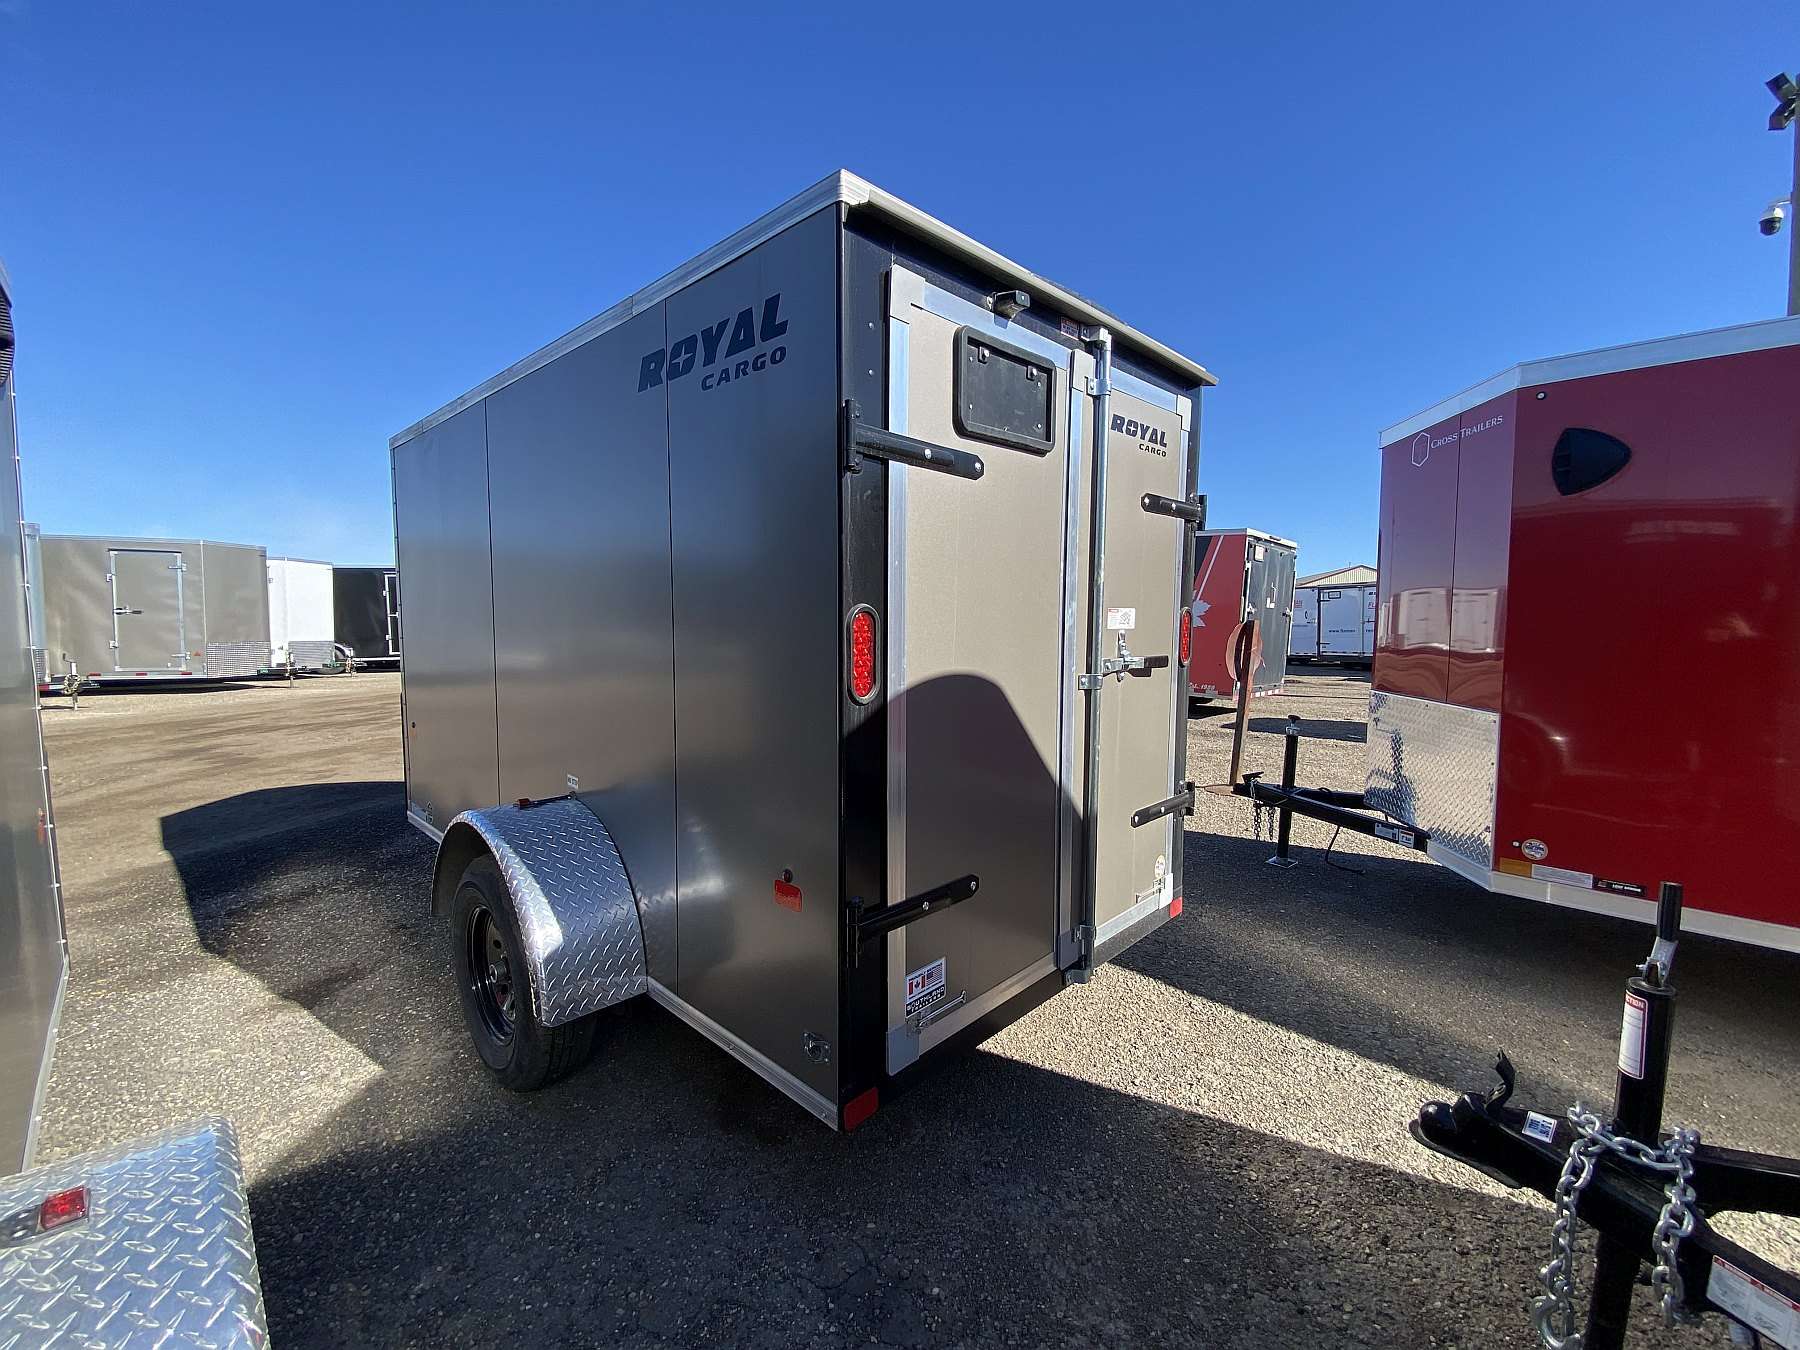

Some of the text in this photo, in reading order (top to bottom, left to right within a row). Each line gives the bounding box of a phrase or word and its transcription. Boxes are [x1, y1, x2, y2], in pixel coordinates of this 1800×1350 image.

[637, 293, 789, 392] ROYAL
[701, 345, 787, 391] CARGO
[1110, 413, 1168, 448] ROYAL
[1431, 415, 1504, 449] CROSS TRAILERS
[1139, 443, 1167, 458] CARGO
